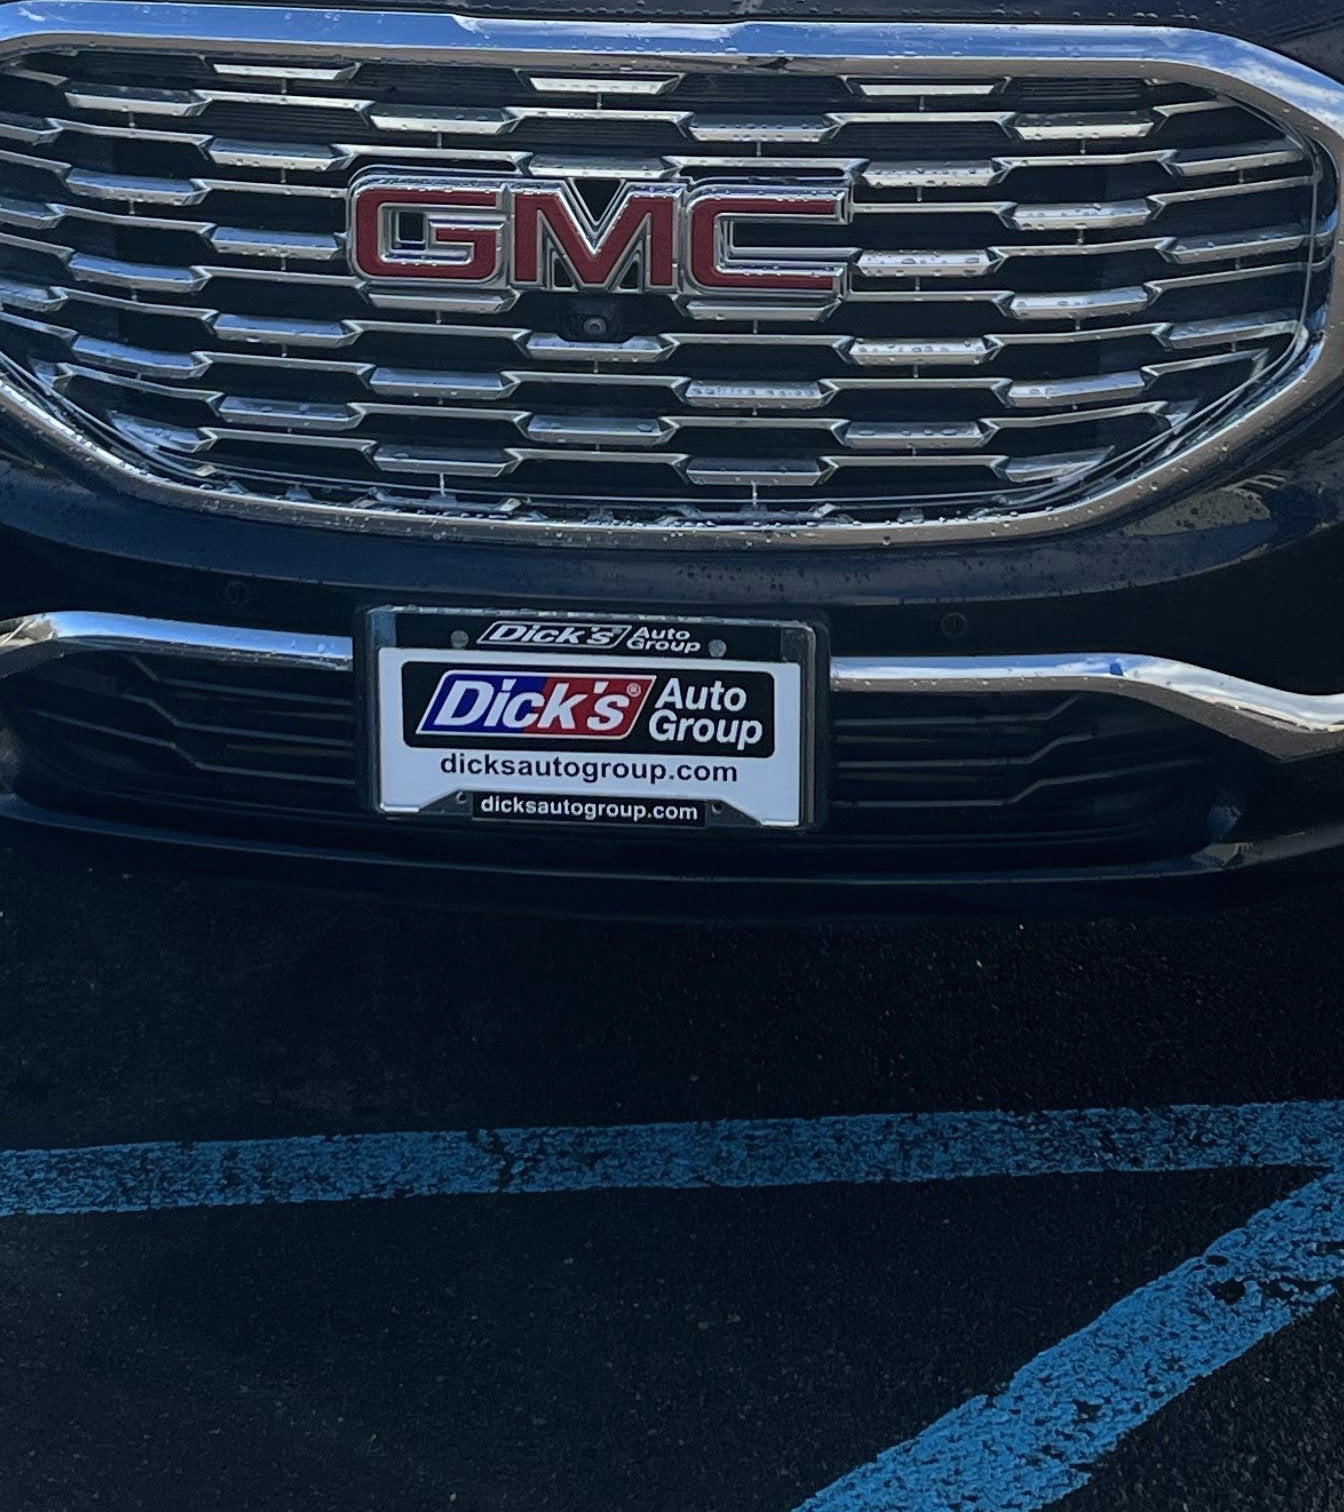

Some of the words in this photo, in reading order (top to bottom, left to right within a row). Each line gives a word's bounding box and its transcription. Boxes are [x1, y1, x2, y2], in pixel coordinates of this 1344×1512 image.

[348, 172, 852, 296] GMC
[488, 624, 616, 646] Dick's
[625, 637, 702, 654] Group
[631, 626, 691, 640] Auto
[433, 678, 630, 731] Dick's
[655, 677, 747, 712] Auto
[648, 710, 763, 751] Group
[440, 753, 738, 784] dicksautogroup.com
[480, 795, 699, 821] dicksautogroup.com
